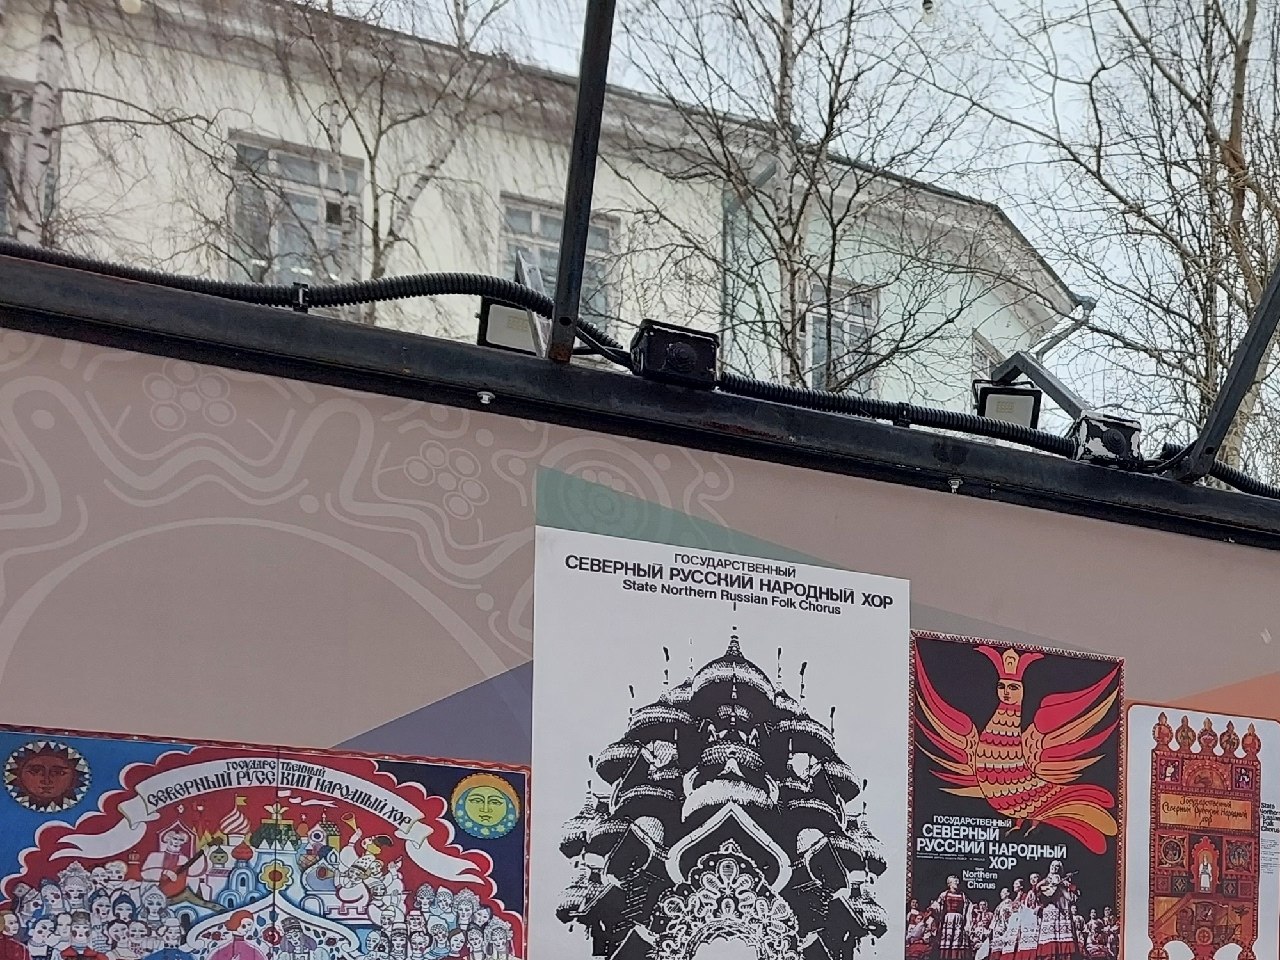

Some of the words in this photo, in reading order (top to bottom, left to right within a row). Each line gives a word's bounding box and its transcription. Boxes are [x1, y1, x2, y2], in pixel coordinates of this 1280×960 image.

[674, 553, 796, 578] ГОСУДАРСТВЕННЫЙ
[565, 554, 663, 580] СЕВЕРНЫЙ
[669, 567, 754, 590] РУССКИЙ
[760, 578, 855, 605] НАРОДНЫЙ
[861, 592, 893, 610] ХОР
[622, 579, 657, 593] State
[661, 583, 717, 599] Northern
[720, 590, 768, 606] Russian
[771, 596, 797, 610] Folk
[799, 600, 841, 615] Chorus
[933, 815, 1012, 828] ГОСУДАРСТВЕННЫЙ
[922, 823, 999, 841] СЕВЕРНЫЙ
[916, 838, 984, 854] РУССКИЙ
[988, 843, 1067, 861] НАРОДНЫЙ
[988, 855, 1017, 870] ХОР
[962, 869, 998, 879] Northern
[967, 880, 996, 889] Chorus
